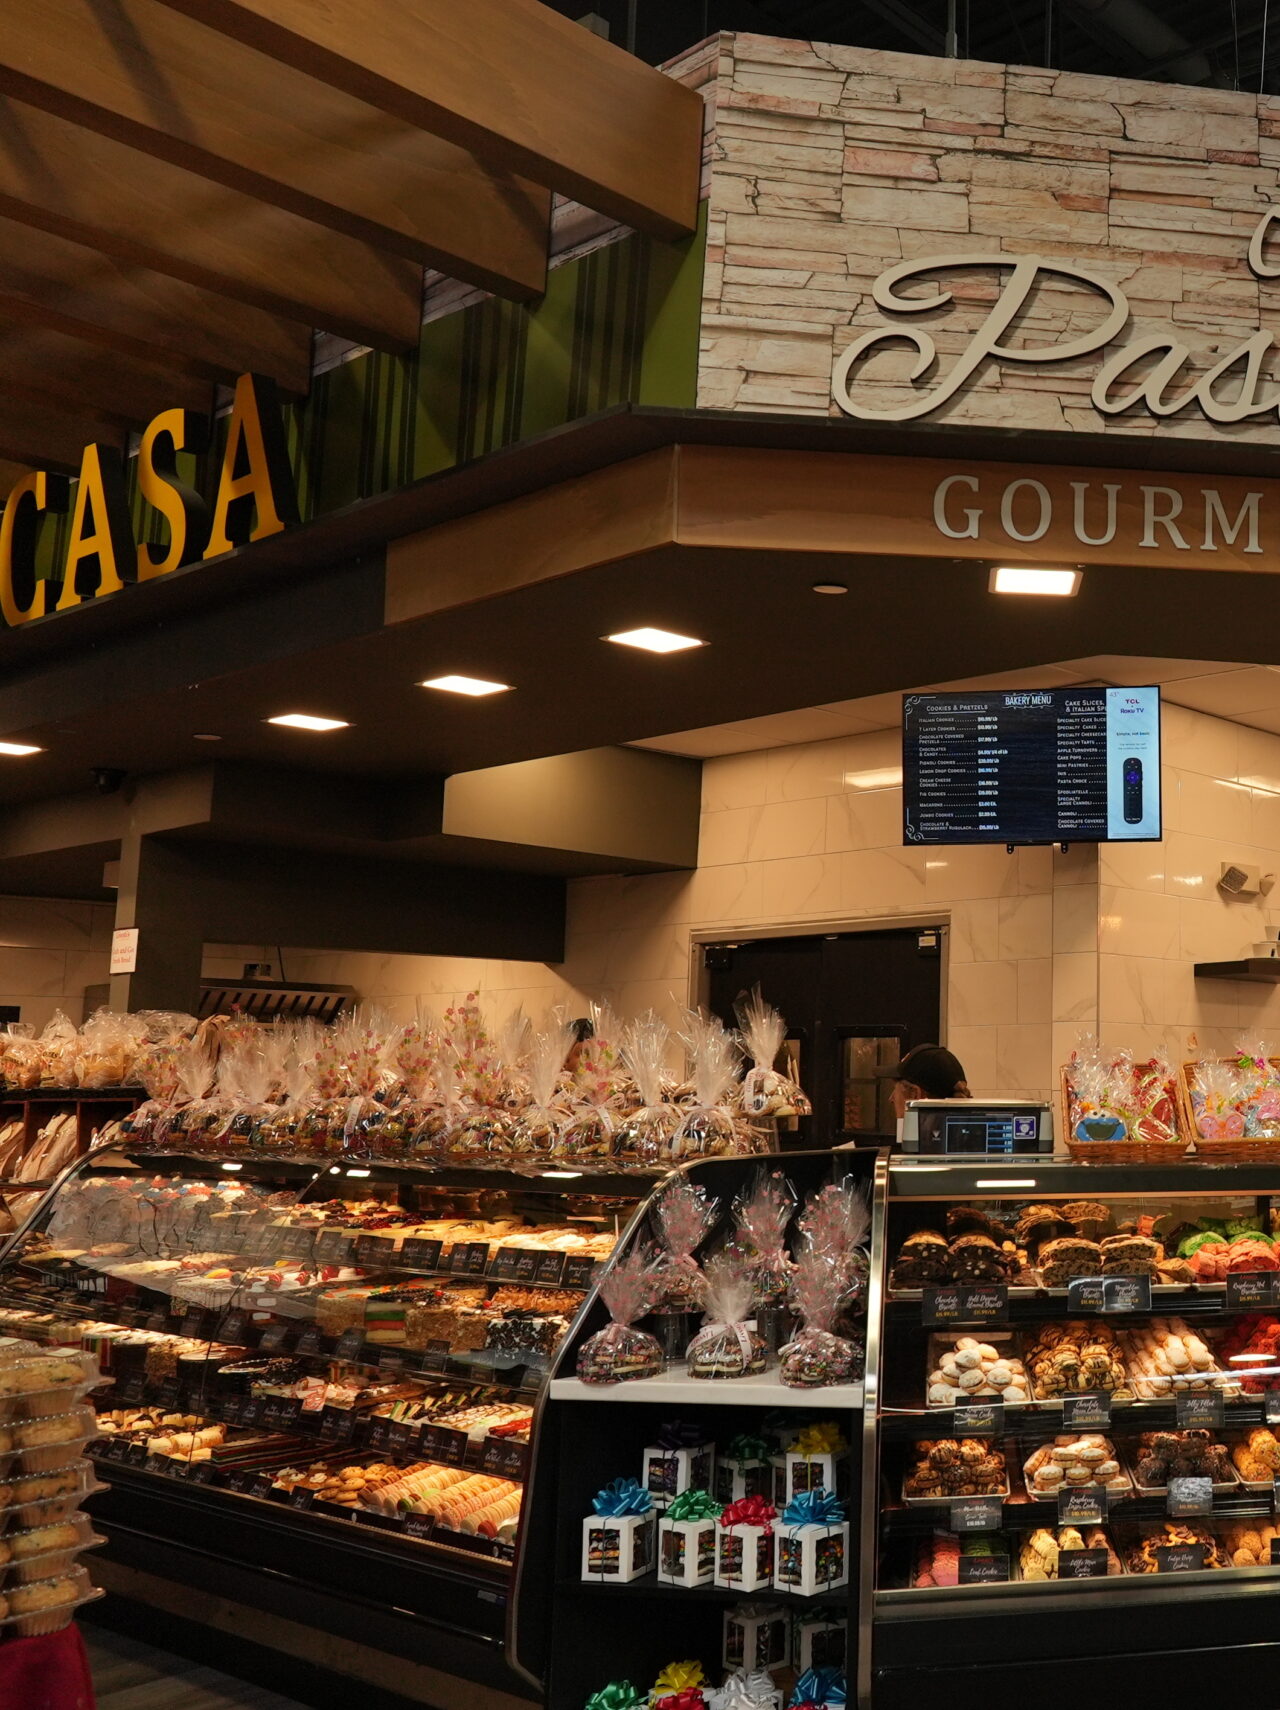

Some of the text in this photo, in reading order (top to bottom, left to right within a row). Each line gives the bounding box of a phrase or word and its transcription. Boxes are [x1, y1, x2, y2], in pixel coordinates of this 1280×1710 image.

[0, 371, 285, 627] CASA
[1004, 696, 1052, 706] BAKERY MENU
